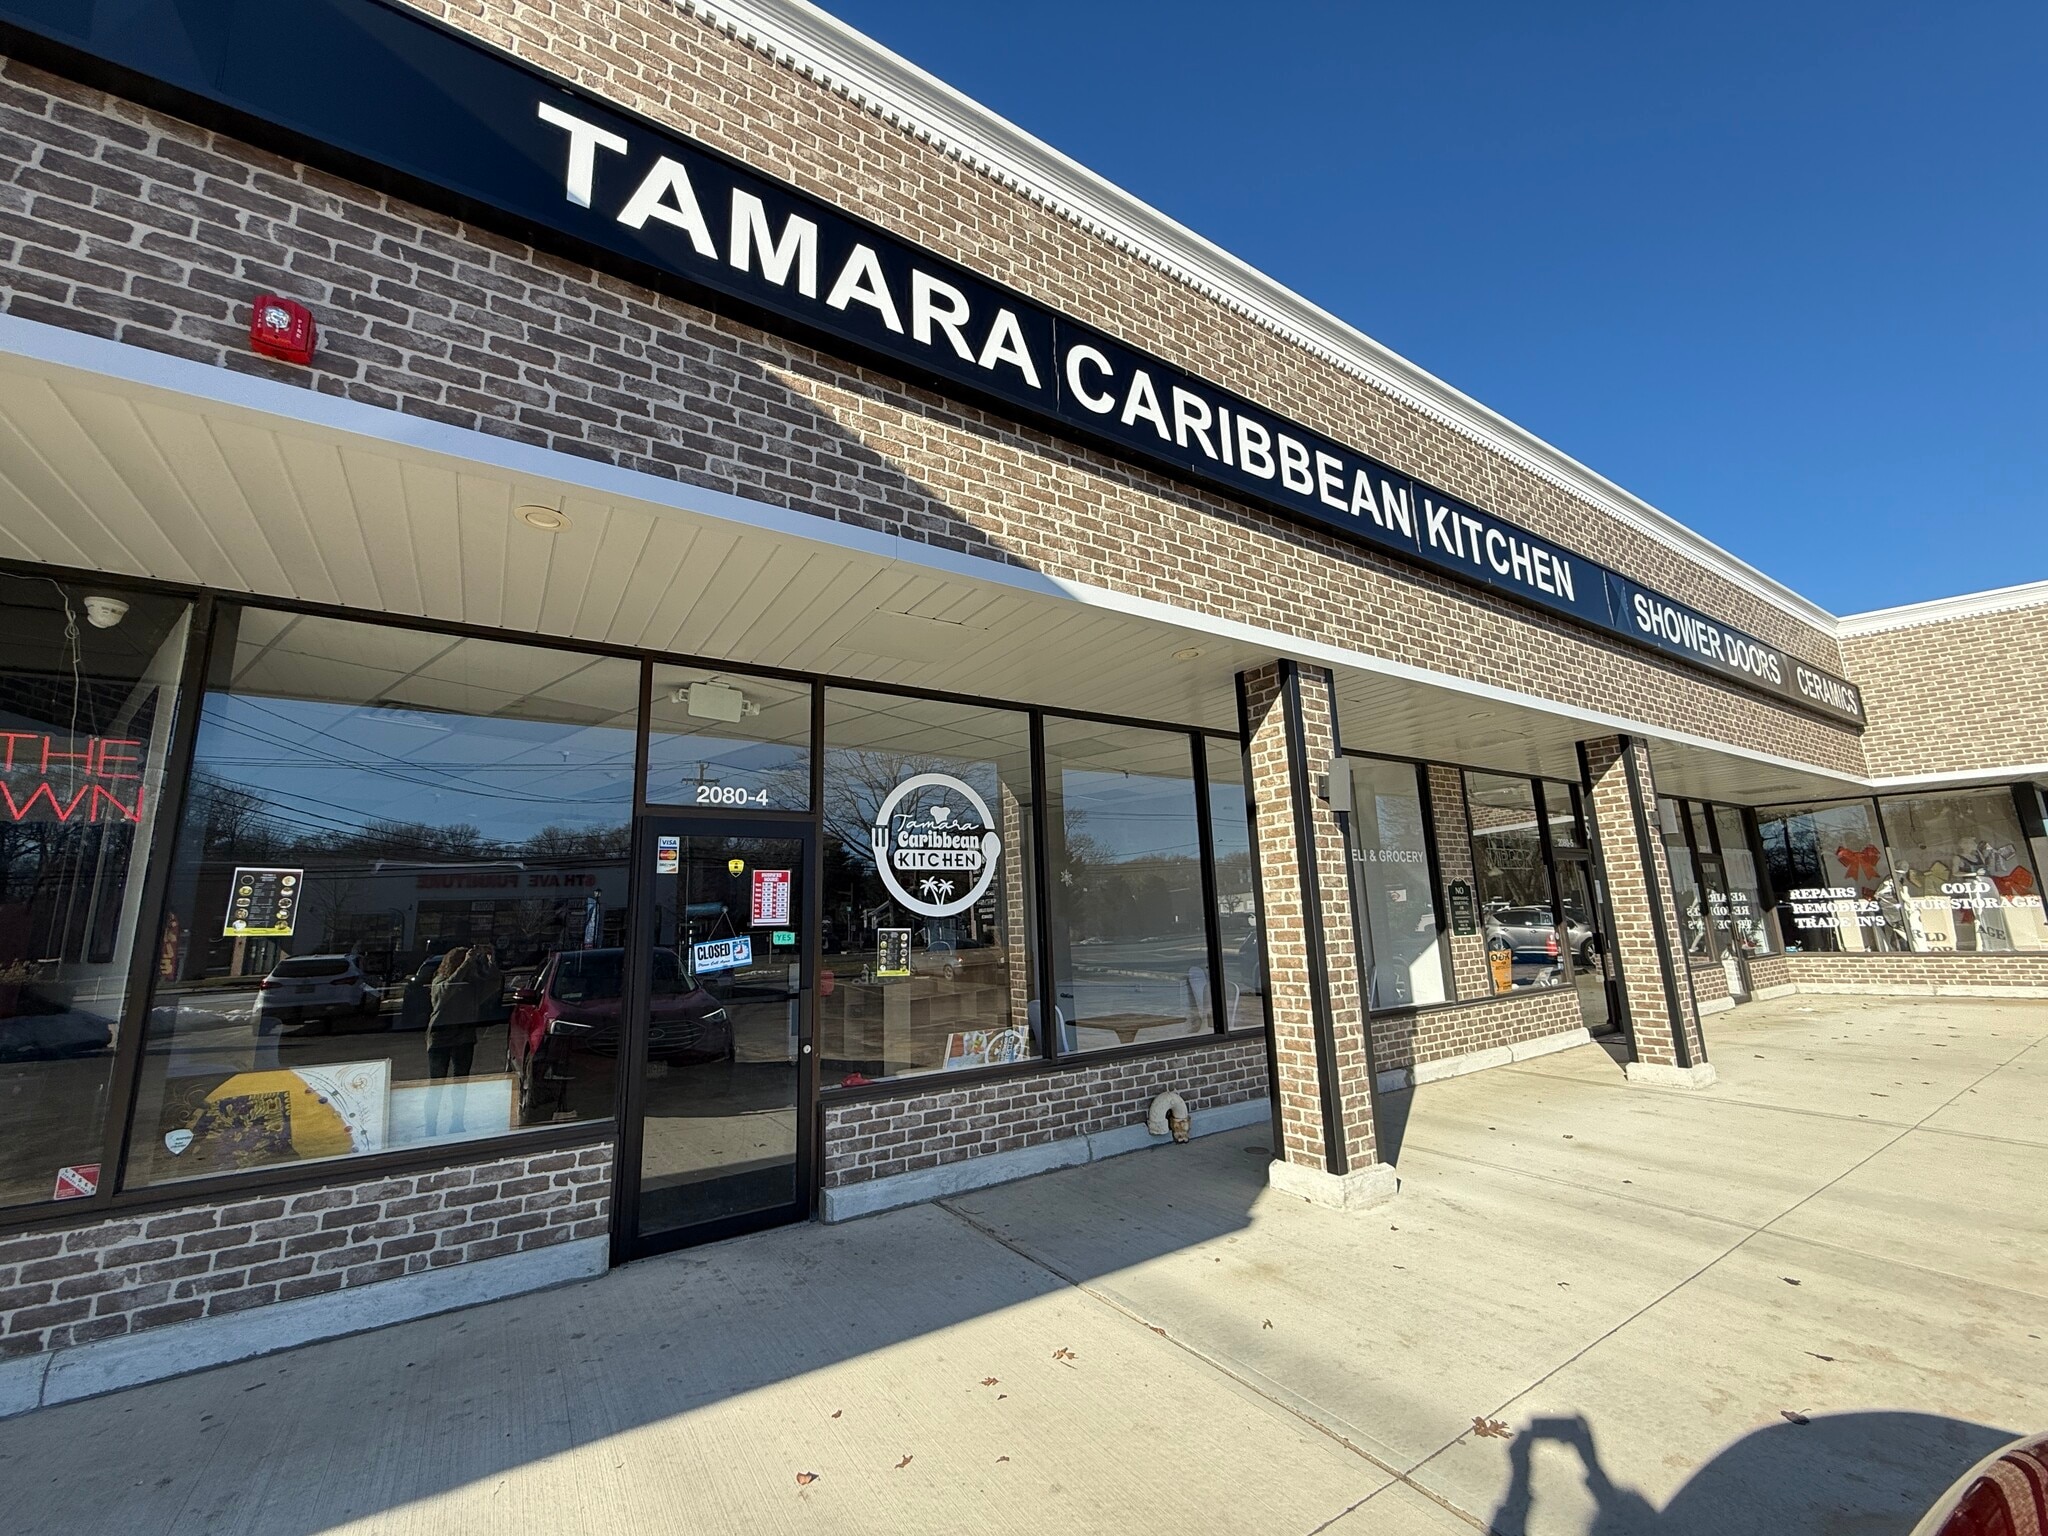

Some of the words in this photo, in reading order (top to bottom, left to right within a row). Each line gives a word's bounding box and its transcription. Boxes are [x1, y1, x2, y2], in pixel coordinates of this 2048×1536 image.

[537, 101, 1042, 389] TAMARA
[1066, 344, 1412, 539] CARIBBEAN
[1424, 499, 1576, 602] KITCHEN
[1634, 593, 1725, 662] SHOWER
[1723, 632, 1782, 685] DOORS
[1796, 666, 1859, 716] CERAMICS
[0, 732, 142, 779] THE
[696, 785, 769, 806] 2080-4
[893, 813, 980, 832] Tamara
[897, 831, 980, 849] Caribbean
[898, 852, 977, 868] KITCHEN
[1351, 849, 1367, 862] ELI
[1369, 849, 1377, 862] &
[1379, 850, 1424, 863] GROCERY
[1454, 886, 1464, 895] NO
[1789, 887, 1857, 900] REPAIRS
[1941, 882, 1991, 894] COLD
[1791, 900, 1880, 914] REMODELS
[1911, 900, 1948, 910] FUR
[1950, 896, 2041, 910] STORAGE
[1794, 917, 1850, 929] TRADE
[1854, 915, 1886, 927] IN'S
[697, 942, 731, 961] CLOSED
